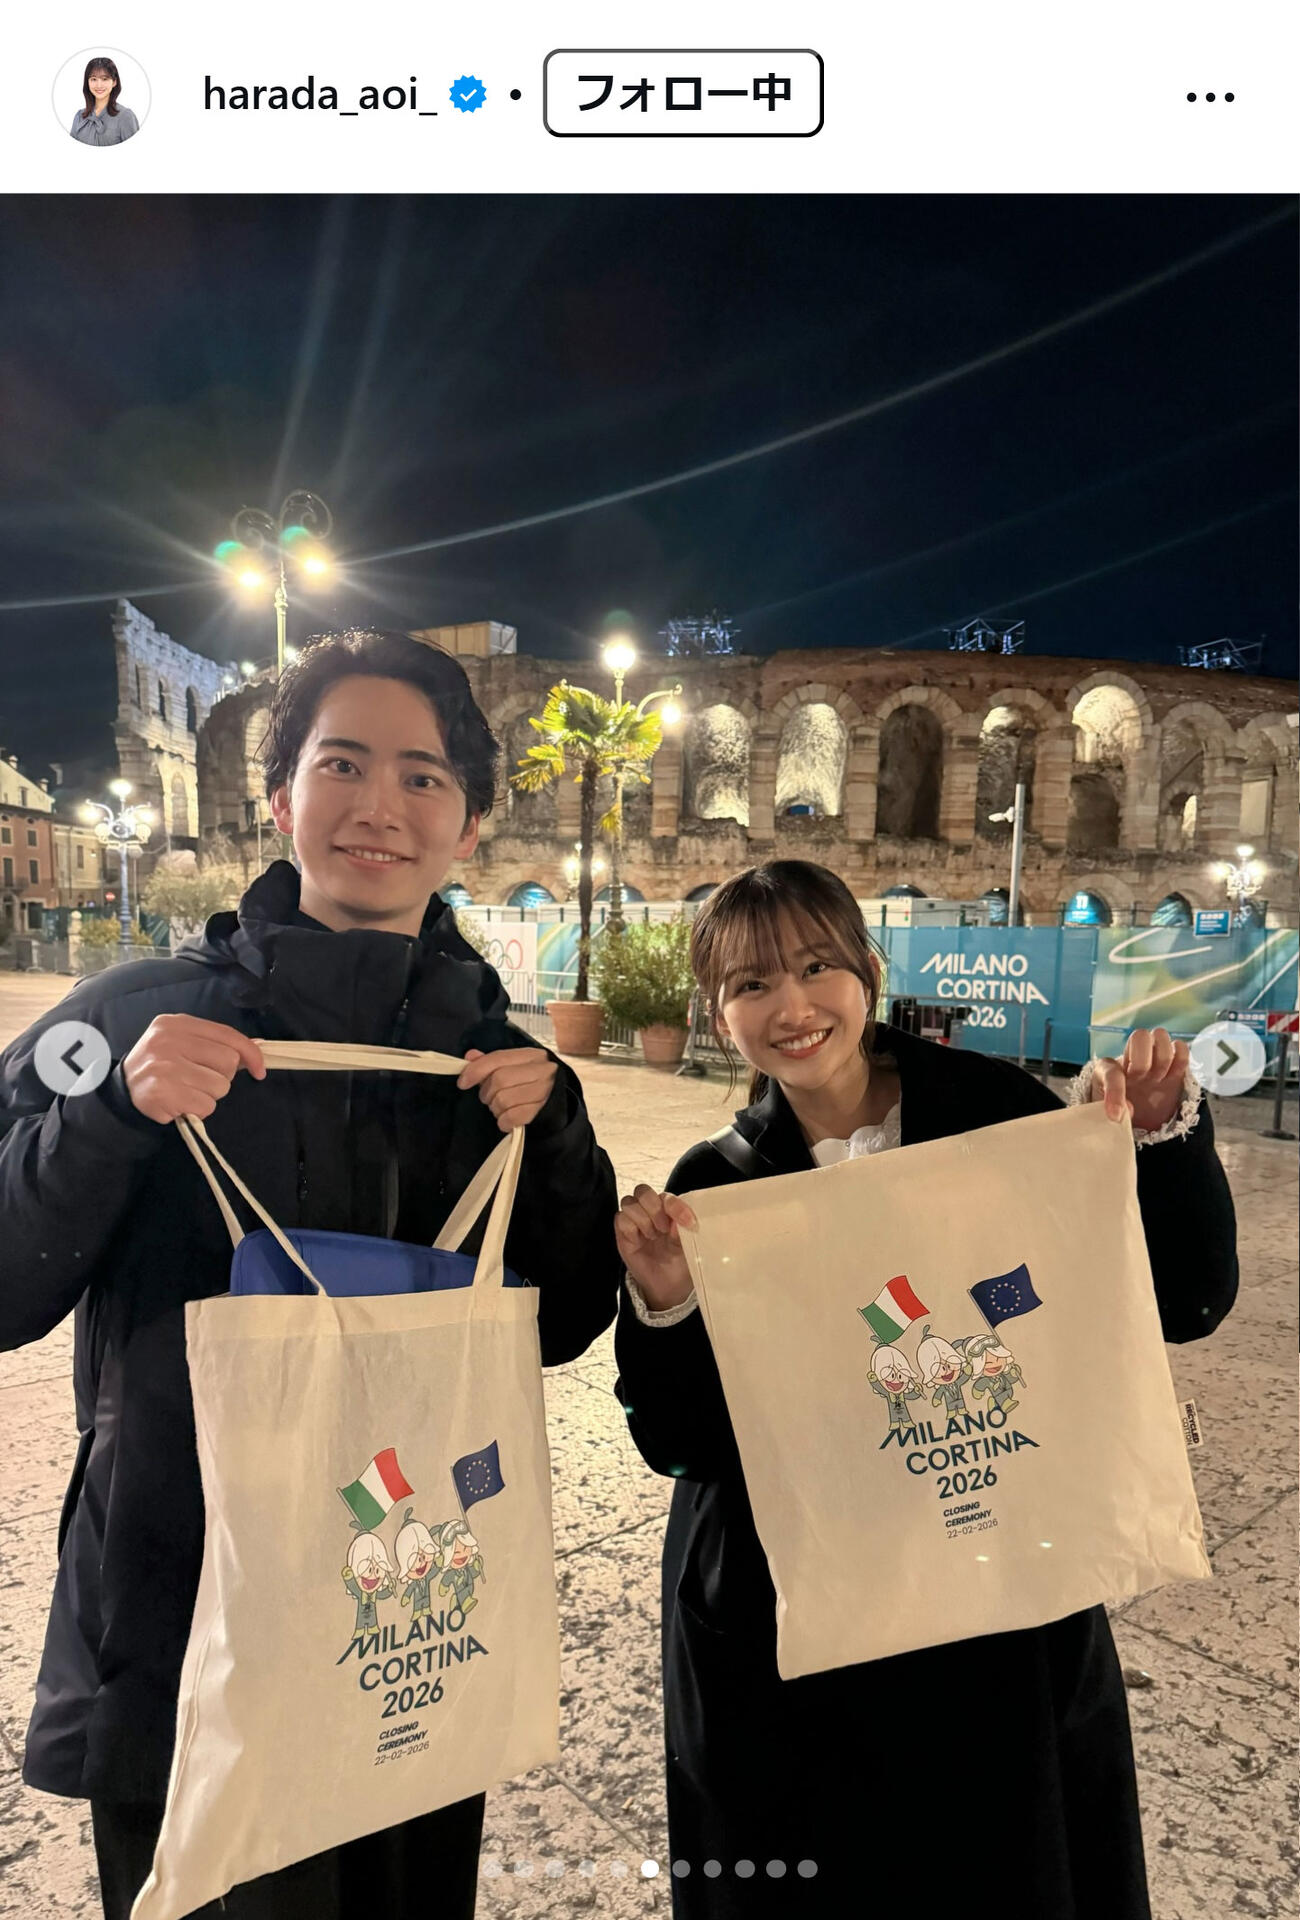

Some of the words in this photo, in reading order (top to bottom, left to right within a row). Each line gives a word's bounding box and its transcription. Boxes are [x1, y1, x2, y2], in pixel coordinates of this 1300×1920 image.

[919, 952, 1028, 977] MILANO
[936, 977, 1050, 1006] CORTINA
[878, 1406, 1007, 1450] MILANO
[1185, 1403, 1200, 1444] RECYCLED
[906, 1430, 1041, 1475] CORTINA
[936, 1464, 998, 1500] 2026
[943, 1501, 981, 1517] CLOSING
[945, 1508, 992, 1528] CEREMONY
[946, 1517, 999, 1540] 22-02-2026
[336, 1605, 466, 1665] MILANO
[360, 1634, 489, 1691] CORTINA
[381, 1676, 444, 1719] 2026
[377, 1729, 429, 1753] CEREMONY
[379, 1720, 419, 1740] CLOSING
[374, 1740, 430, 1766] 22-02-2026
